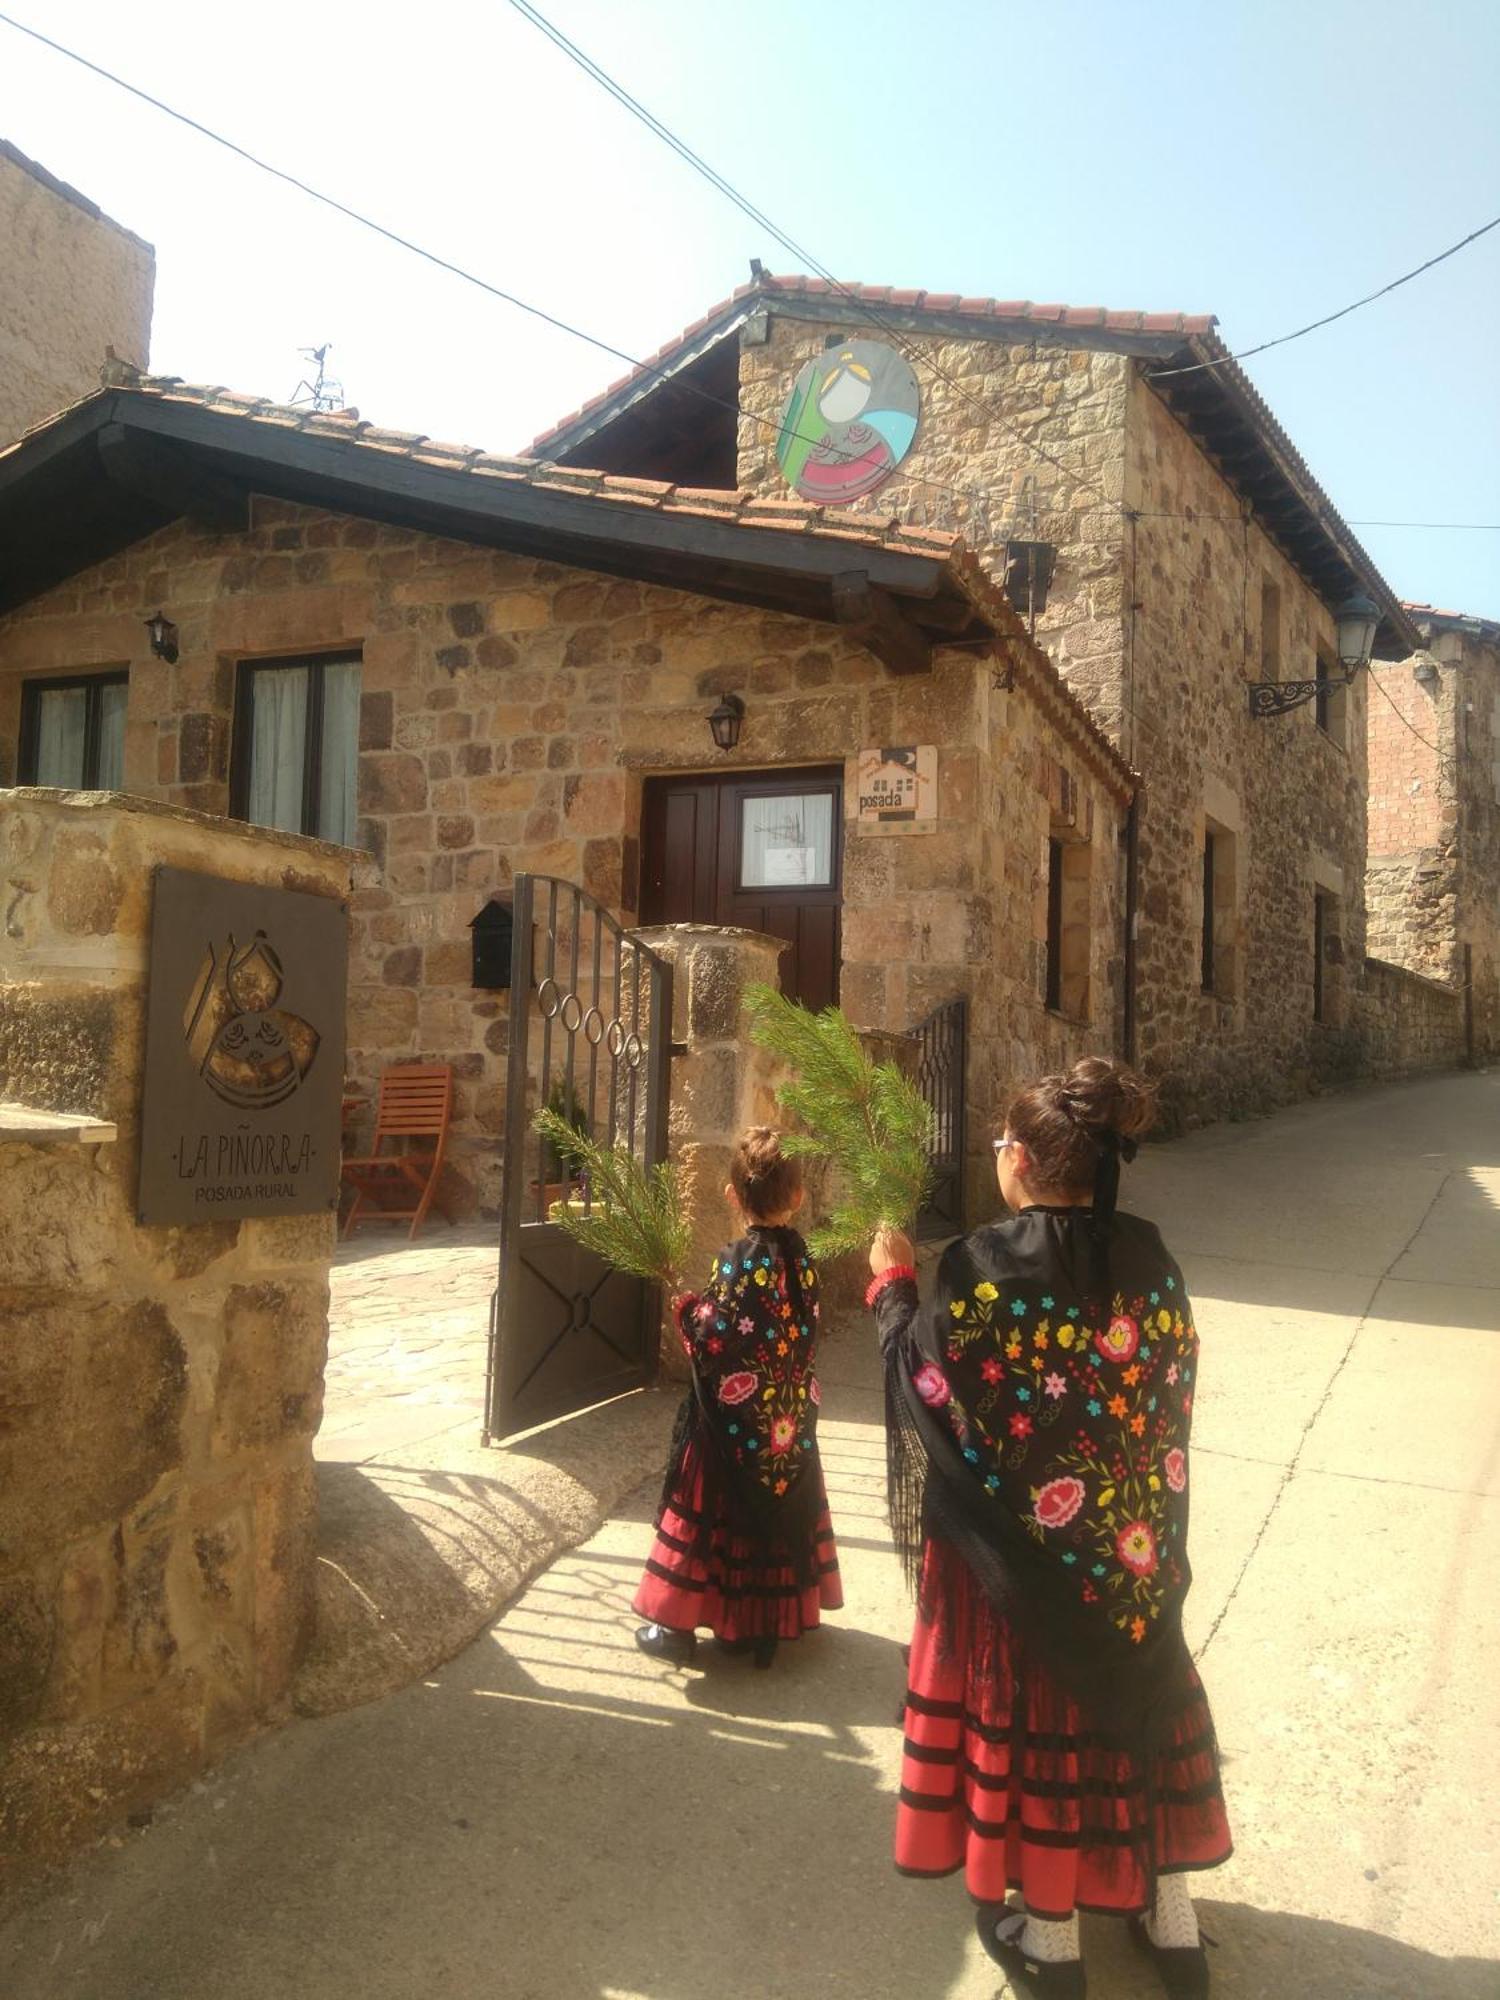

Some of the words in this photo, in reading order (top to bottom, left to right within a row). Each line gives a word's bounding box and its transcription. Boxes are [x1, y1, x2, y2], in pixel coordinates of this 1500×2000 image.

[860, 789, 902, 816] posada
[179, 1135, 209, 1178] LA
[217, 1123, 311, 1177] PIÑORRA
[195, 1185, 252, 1202] POSADA
[255, 1183, 297, 1199] RURAL
